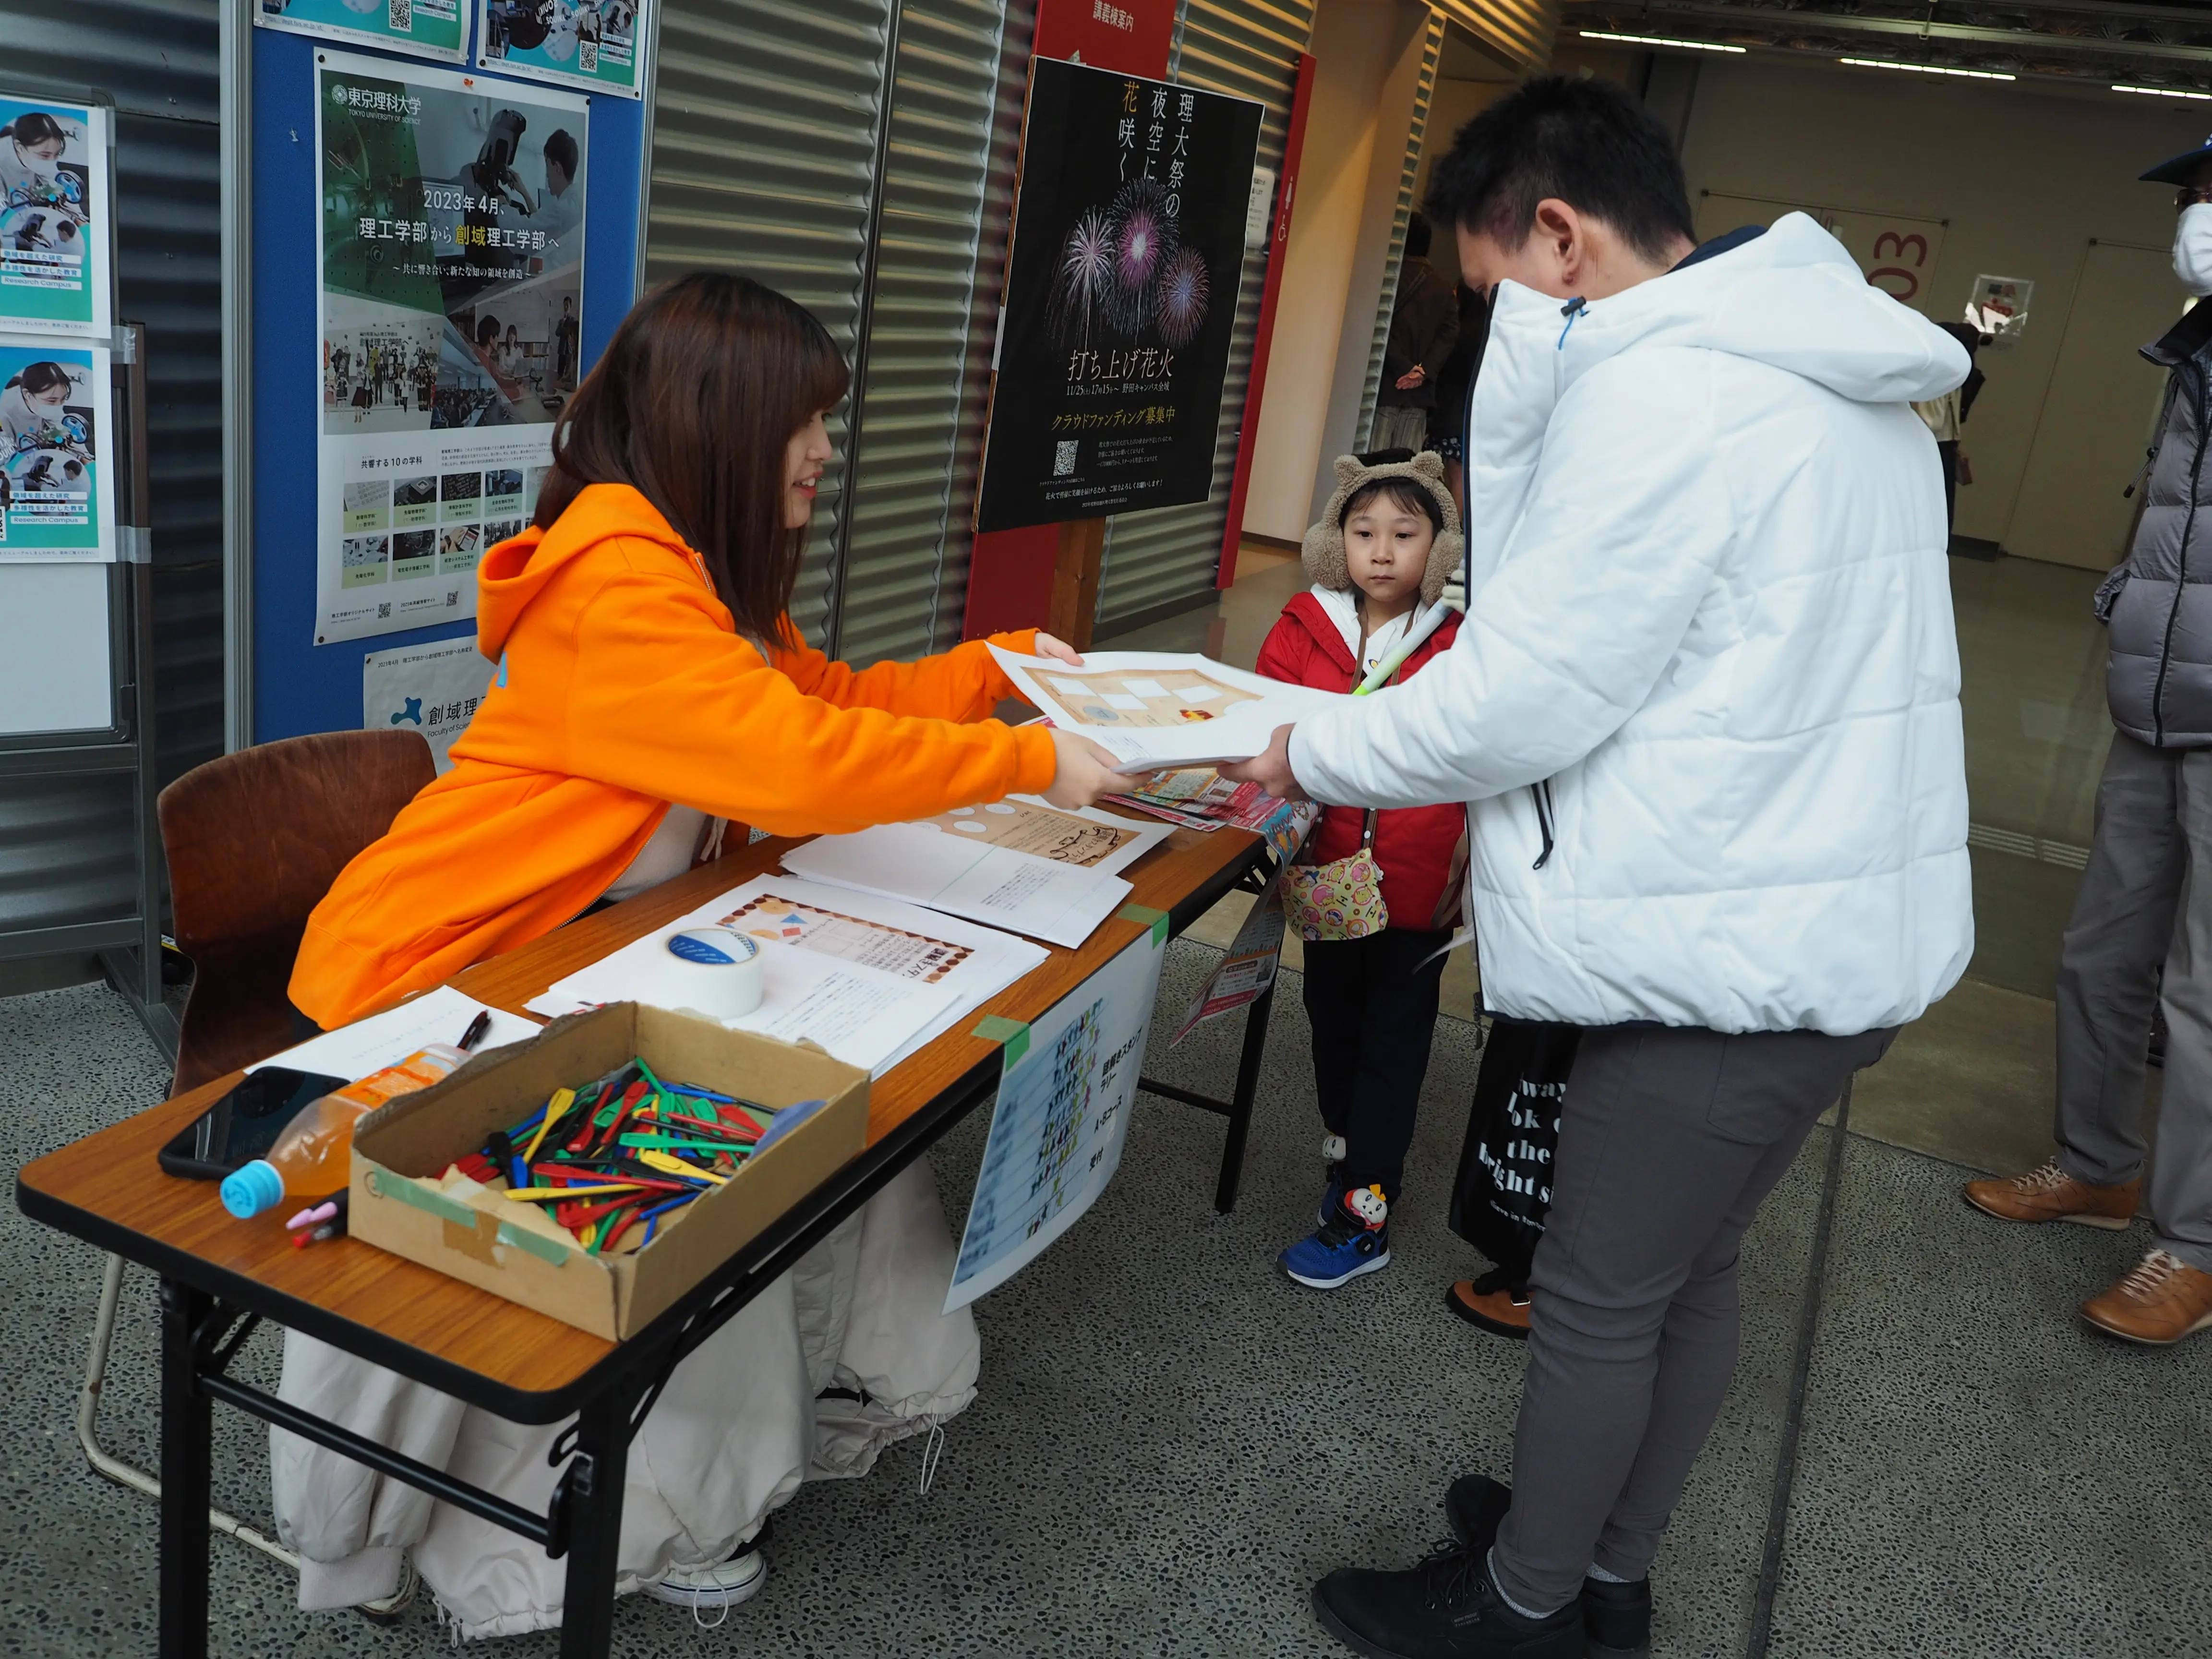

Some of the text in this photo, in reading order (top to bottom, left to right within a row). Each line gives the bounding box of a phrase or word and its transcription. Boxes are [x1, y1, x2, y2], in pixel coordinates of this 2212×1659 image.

[1093, 0, 1133, 33] 講義棟案内
[348, 87, 421, 115] 東京理科大学
[349, 108, 365, 117] TOKYO
[366, 111, 394, 121] UNIVERSITY
[402, 117, 421, 126] SCIENCE
[1118, 81, 1140, 182] 花咲く
[1144, 87, 1167, 180] 夜空に
[1165, 93, 1194, 218] 理大祭の
[360, 217, 559, 251] 理工学部から創域理工学部へ
[5, 277, 72, 288] Research Campus
[1067, 348, 1174, 381] 打ち上げ花火
[1121, 381, 1170, 394] 野田キャンパス全域
[1051, 406, 1176, 431] クラウドファンディング募集中
[361, 456, 422, 469] 共響する10の学科
[378, 647, 473, 668] 2023年4月 理工学部から創域理工学部へ名称変更
[428, 696, 486, 726] 創域理
[428, 726, 448, 738] Faculty
[1102, 1026, 1142, 1078] 謎解きスタンプ
[1101, 1072, 1117, 1094] ラリー
[1089, 1146, 1104, 1172] 受付
[1507, 1139, 1551, 1165] the
[1479, 1142, 1535, 1196] bright
